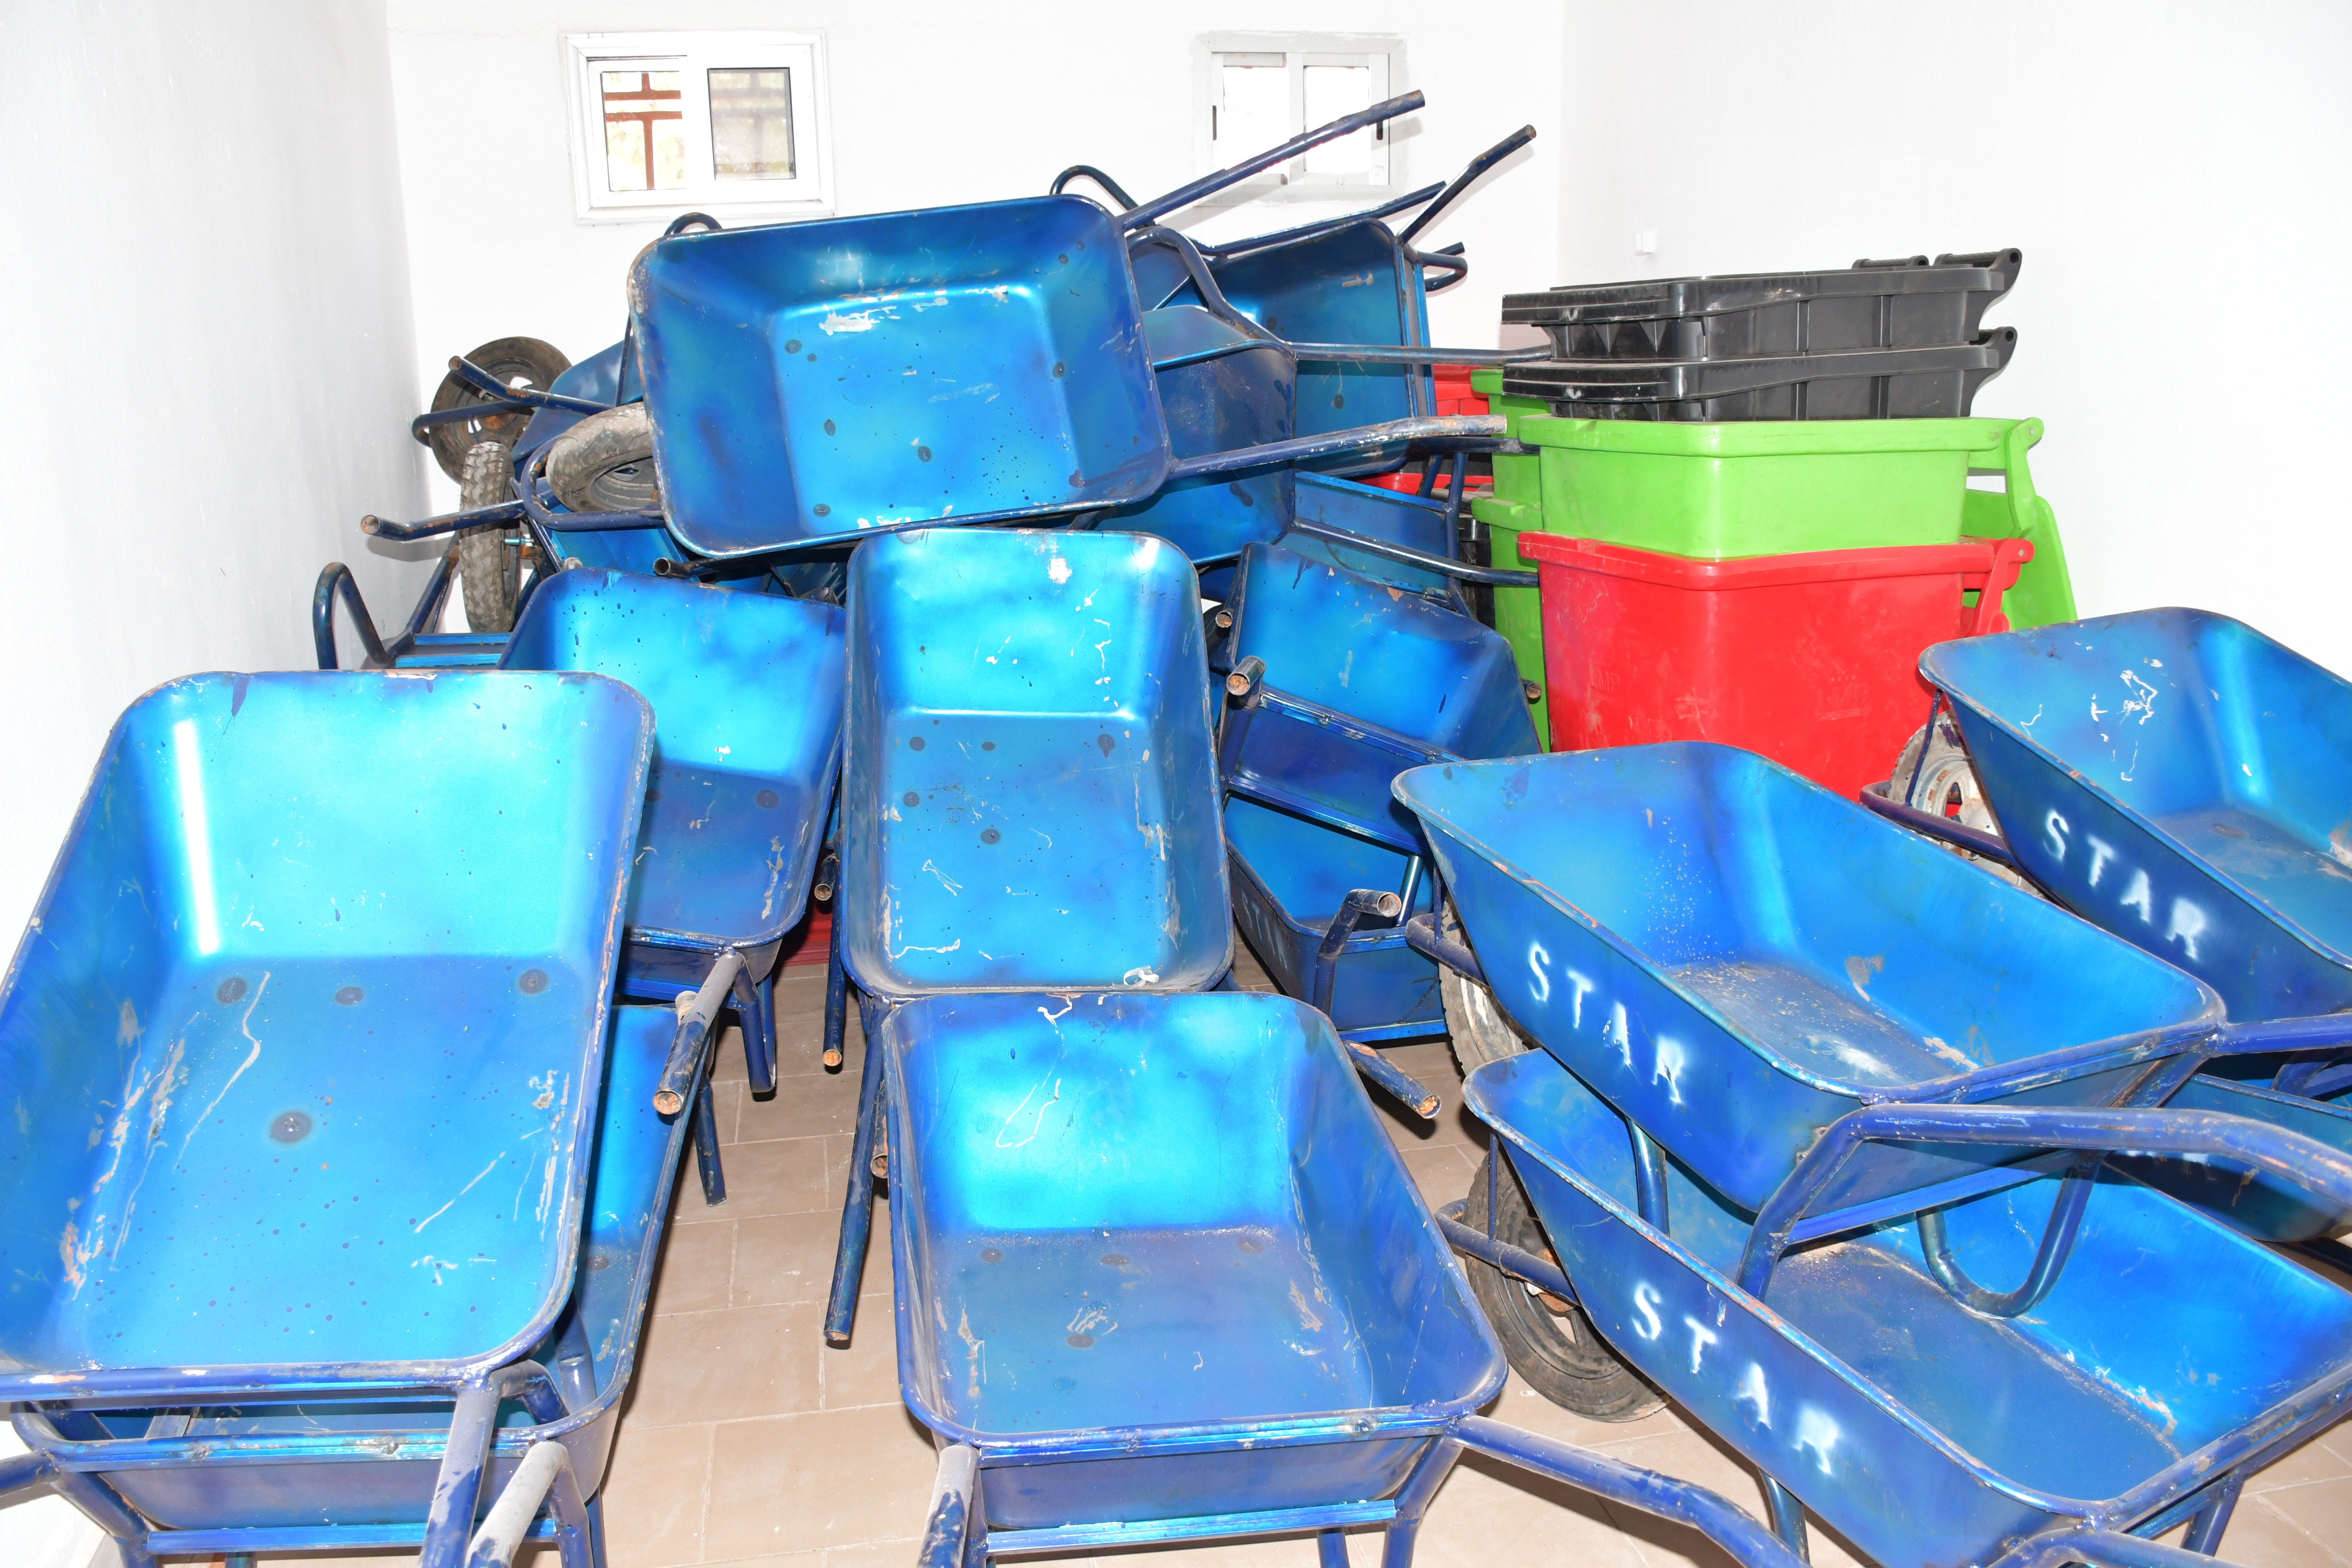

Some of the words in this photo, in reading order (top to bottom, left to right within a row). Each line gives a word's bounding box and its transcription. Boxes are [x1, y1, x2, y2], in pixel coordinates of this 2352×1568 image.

[2043, 808, 2206, 960] STAR
[1528, 941, 1685, 1104] STAR
[1631, 1281, 1841, 1474] STAR
